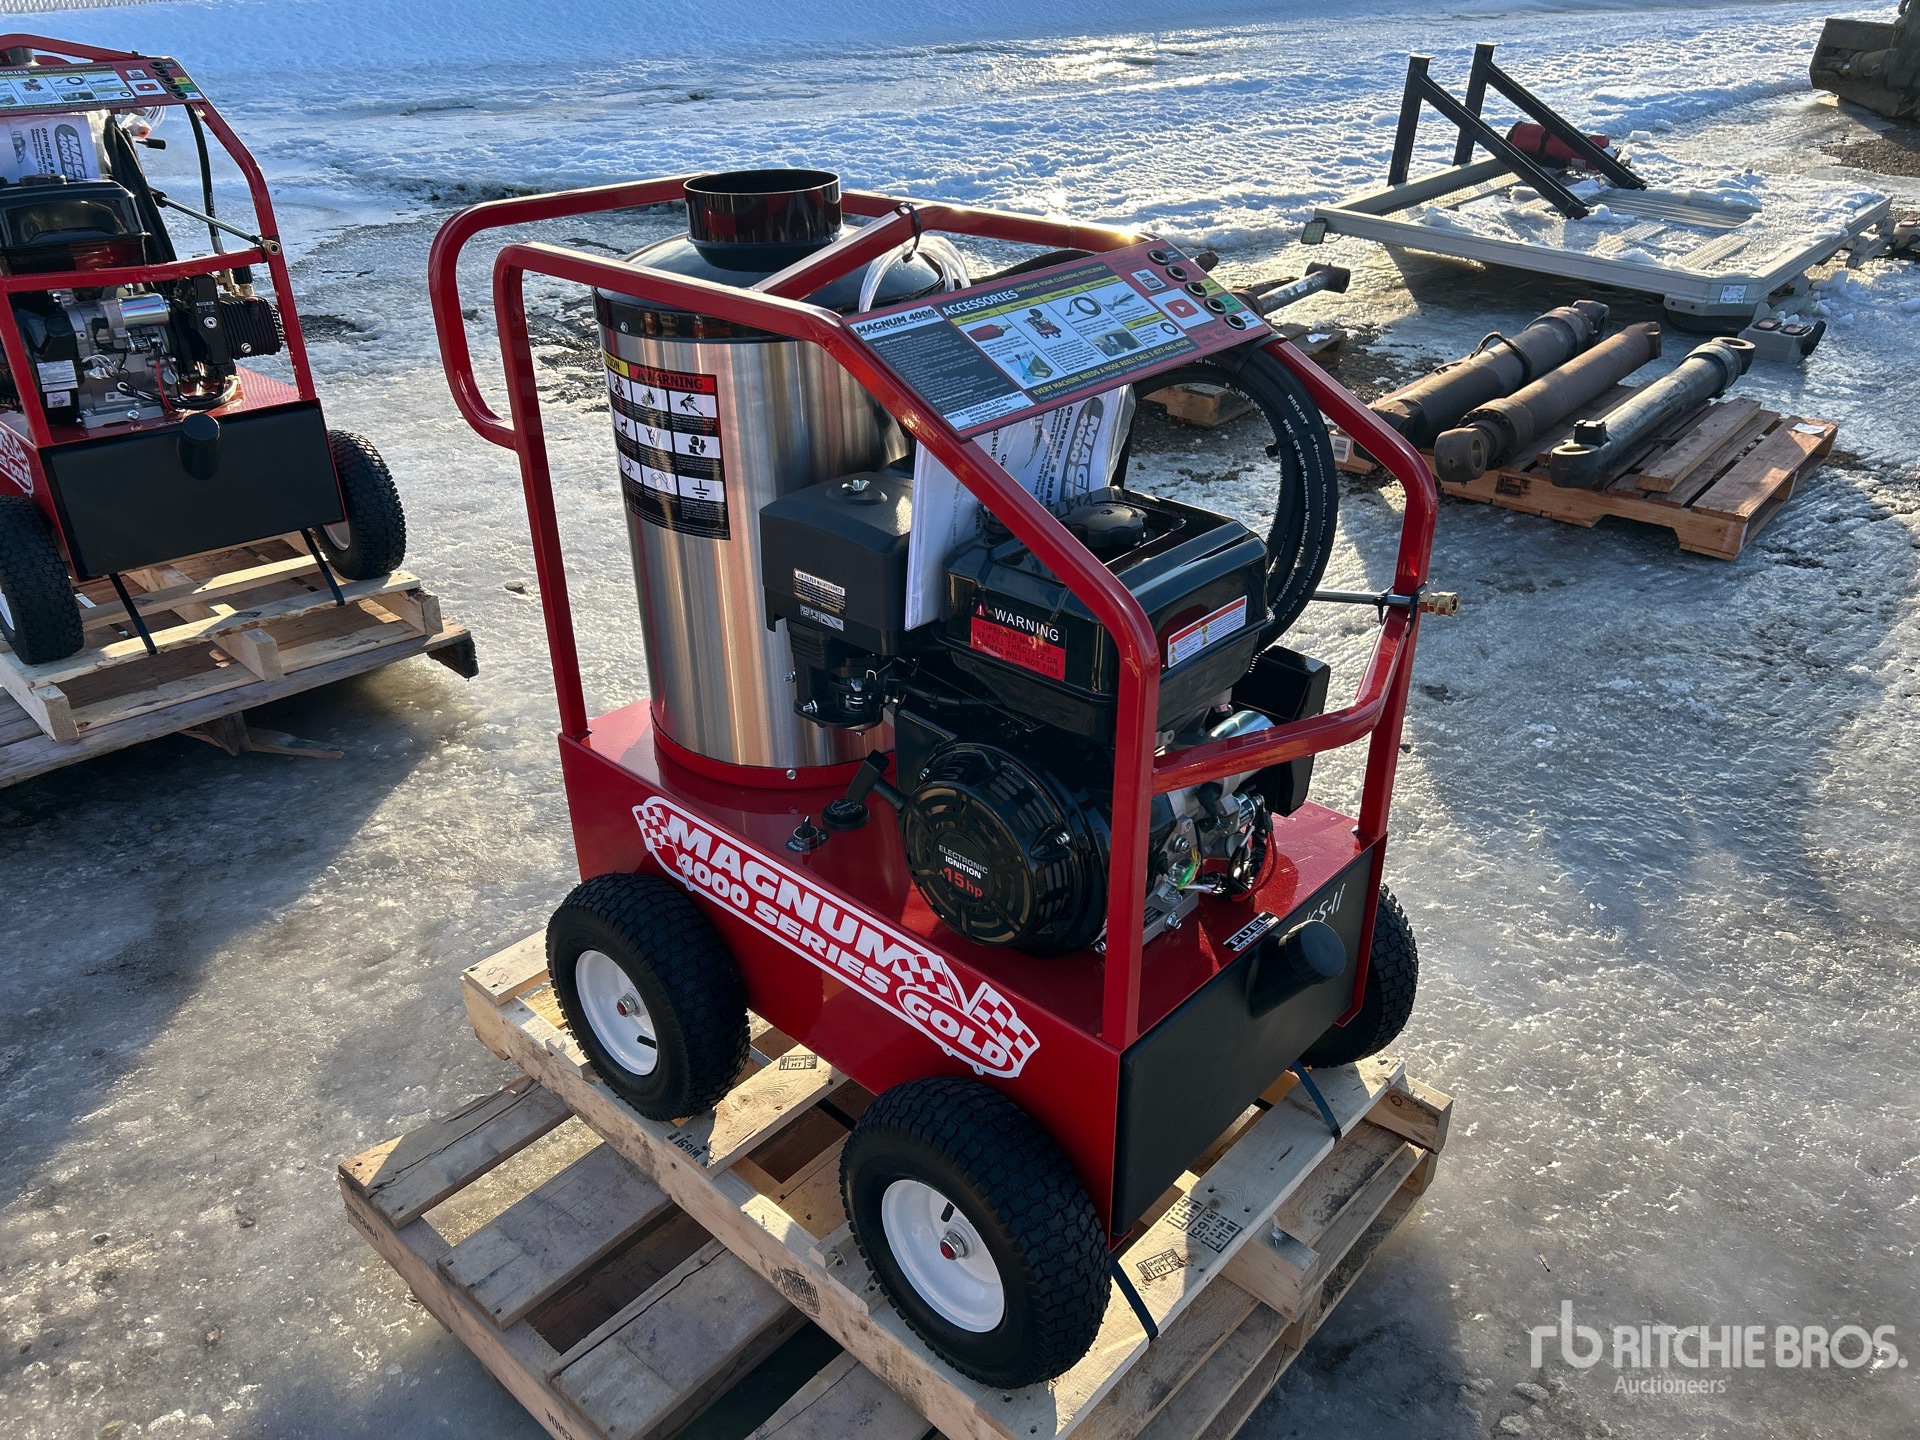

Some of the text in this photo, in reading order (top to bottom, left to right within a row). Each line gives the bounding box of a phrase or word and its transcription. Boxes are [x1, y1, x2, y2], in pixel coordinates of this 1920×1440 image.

[68, 135, 85, 179] MAG
[1015, 283, 1039, 292] IMPROVE
[1054, 272, 1080, 282] CLEANING
[1079, 265, 1106, 276] EFFICIENCY
[942, 289, 1017, 316] ACCESSORIES
[856, 308, 935, 334] MAGNUM 4000
[647, 372, 704, 389] WARNING
[1033, 385, 1053, 395] EVERY
[1053, 375, 1080, 389] MACHINE
[1080, 369, 1099, 379] NEEDS
[1104, 362, 1119, 371] HOSE
[1119, 357, 1135, 366] REEL!
[1135, 352, 1149, 361] CALL
[1051, 409, 1059, 433] Diesel
[999, 454, 1007, 468] OW
[1045, 406, 1073, 508] OWNER'S MAN
[1064, 413, 1088, 498] 4000 SE
[1075, 415, 1100, 496] MAG
[1034, 475, 1042, 495] Fired
[982, 622, 1051, 653] OPERATE MAHINE
[994, 607, 1059, 642] WARNING
[976, 630, 1057, 665] AT FULL THROTTLE OR
[1006, 649, 1022, 661] WILL
[1024, 656, 1040, 668] NOT
[1042, 663, 1059, 675] FIRE
[938, 844, 989, 874] ELECTRONIC
[945, 855, 982, 880] IGNITION
[668, 813, 905, 968] MAGNUM
[674, 853, 891, 994] 4000 SERIES
[1230, 915, 1271, 946] FUEL
[903, 994, 1009, 1068] GOLD
